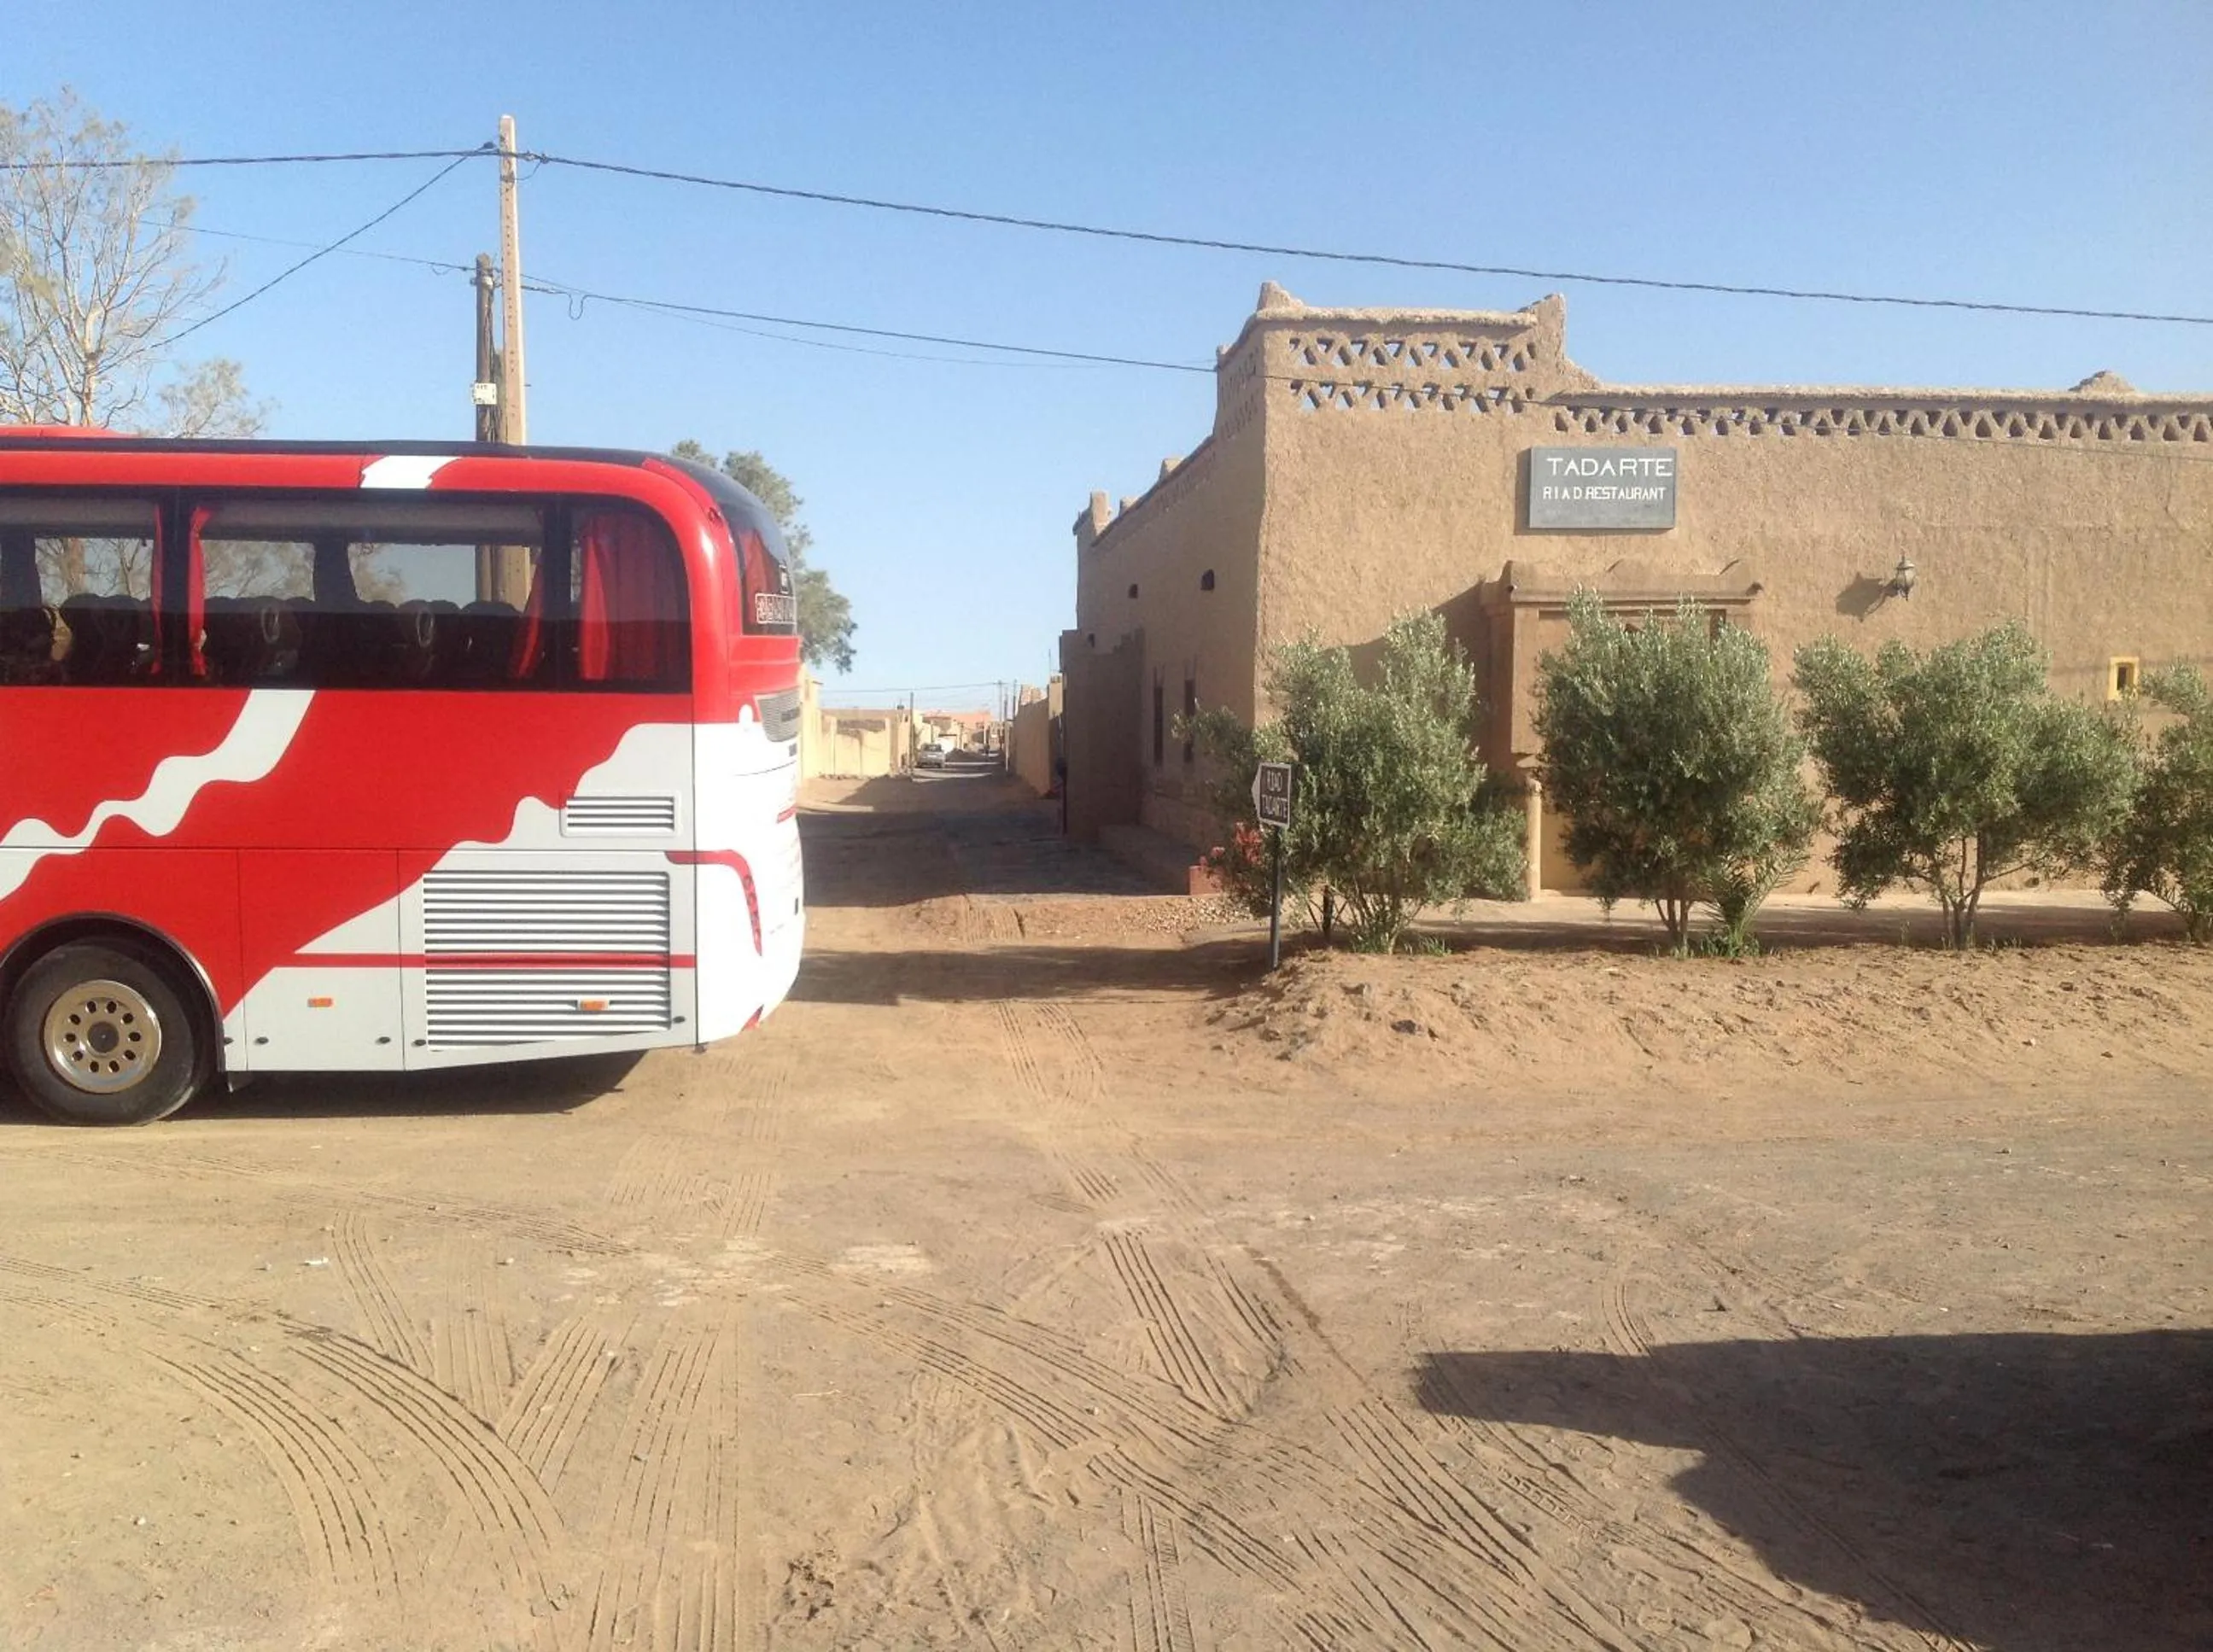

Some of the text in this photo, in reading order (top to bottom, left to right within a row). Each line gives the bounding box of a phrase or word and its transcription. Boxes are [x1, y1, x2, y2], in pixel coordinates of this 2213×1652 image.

[1547, 458, 1673, 476] TADARTE
[1543, 487, 1667, 500] RIAD RESTAURANT
